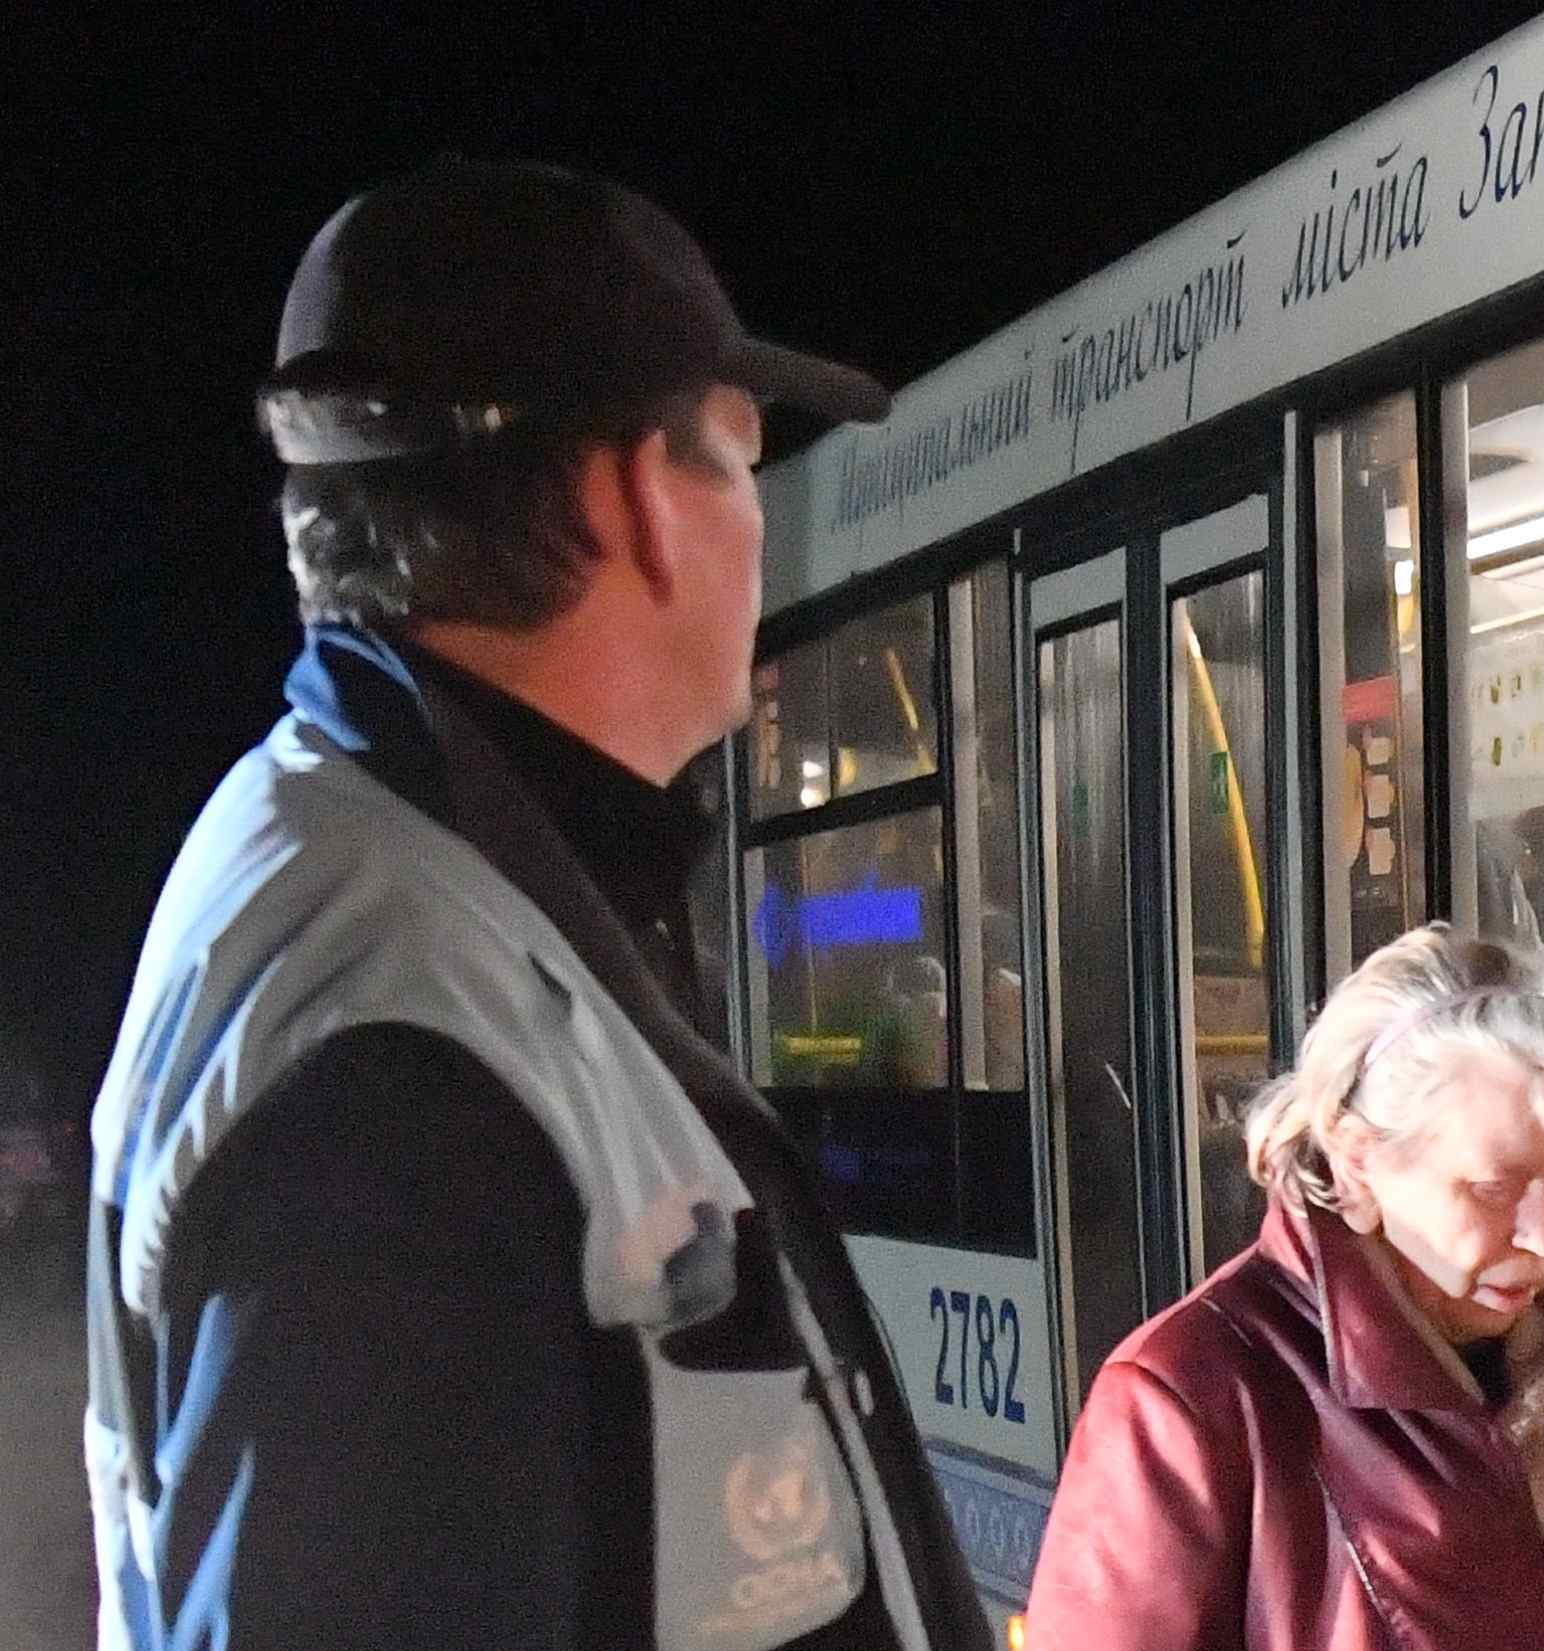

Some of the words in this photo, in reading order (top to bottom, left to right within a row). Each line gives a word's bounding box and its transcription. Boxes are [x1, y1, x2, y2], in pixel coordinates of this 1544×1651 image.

[1050, 228, 1249, 476] транспорт
[1281, 142, 1432, 309] міста
[930, 1286, 1026, 1425] 2782
